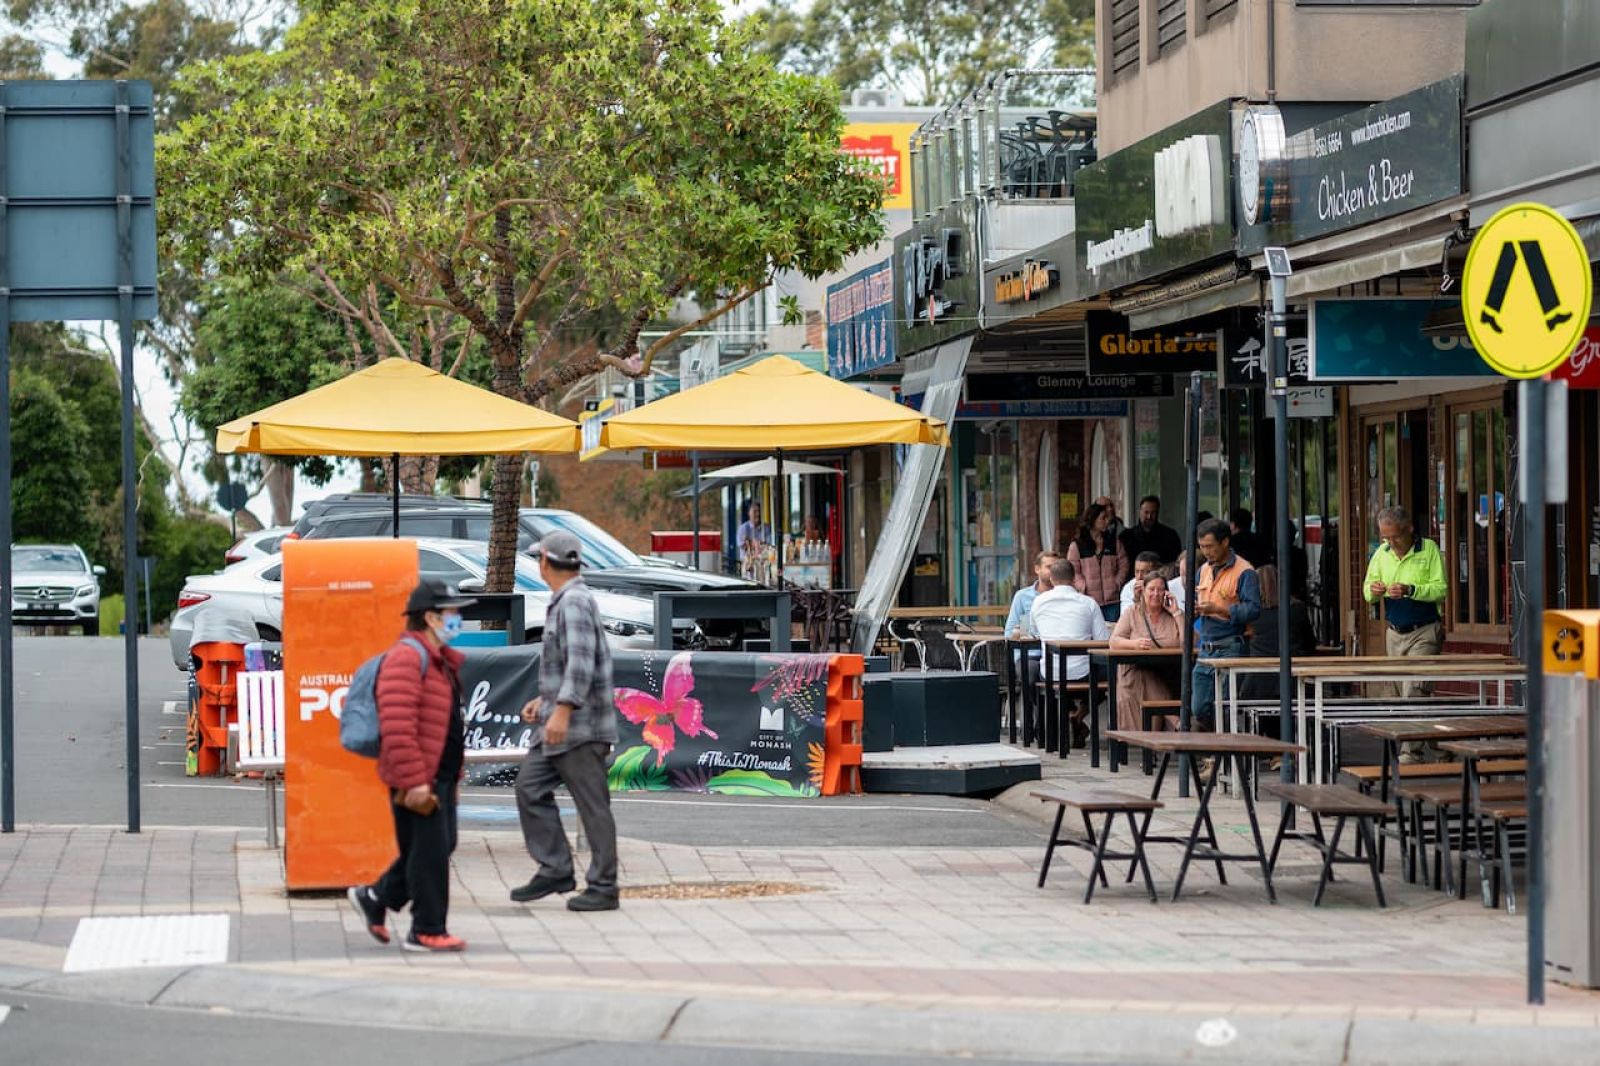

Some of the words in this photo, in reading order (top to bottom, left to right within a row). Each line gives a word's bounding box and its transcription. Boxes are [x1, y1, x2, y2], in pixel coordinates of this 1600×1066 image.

[1318, 170, 1365, 220] Chicken
[1368, 164, 1379, 206] &
[1380, 158, 1415, 202] Beer
[1100, 332, 1178, 355] Gloria
[1088, 374, 1136, 388] Lounge
[750, 741, 792, 750] MONASH
[697, 751, 793, 771] #ThisIsMonash
